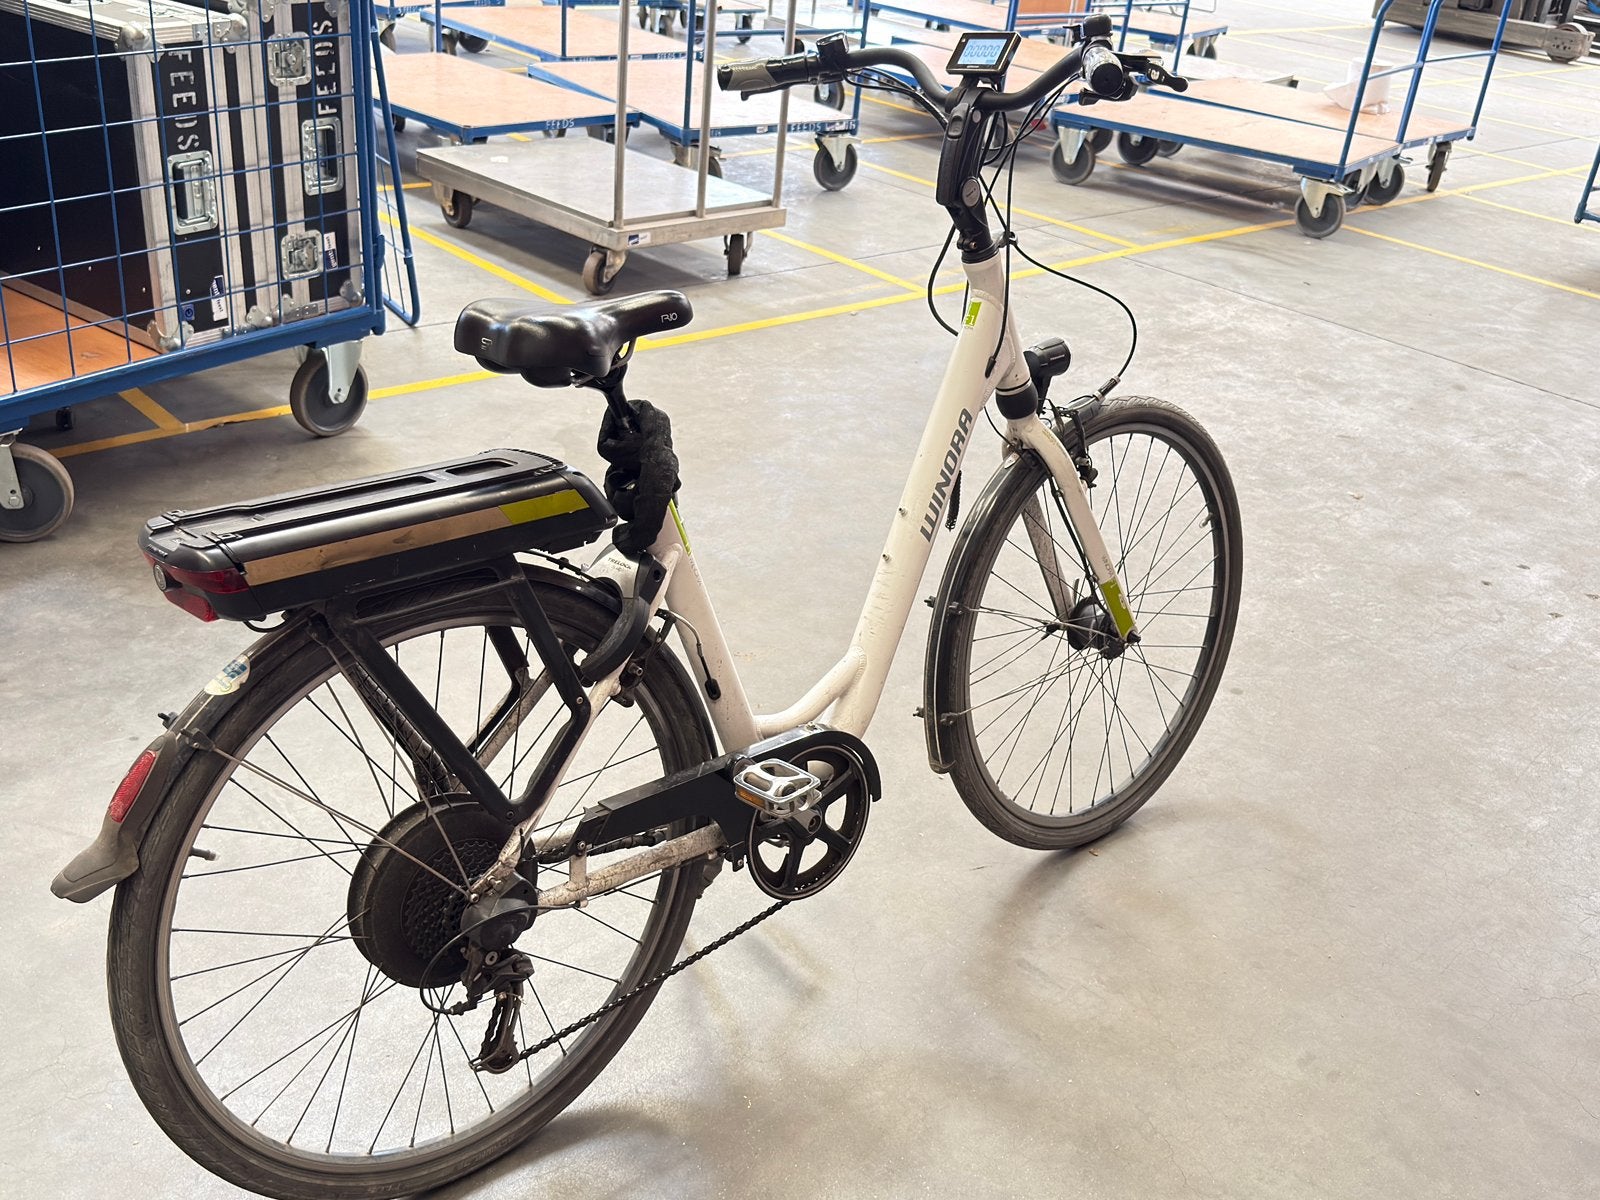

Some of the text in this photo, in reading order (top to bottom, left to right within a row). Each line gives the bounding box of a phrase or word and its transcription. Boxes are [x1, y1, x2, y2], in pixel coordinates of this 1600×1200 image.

[168, 49, 200, 151] FEEDS
[312, 20, 338, 115] FEEDS
[544, 118, 575, 130] FEEDS
[790, 123, 822, 134] FEEDS
[919, 407, 974, 543] WINORA
